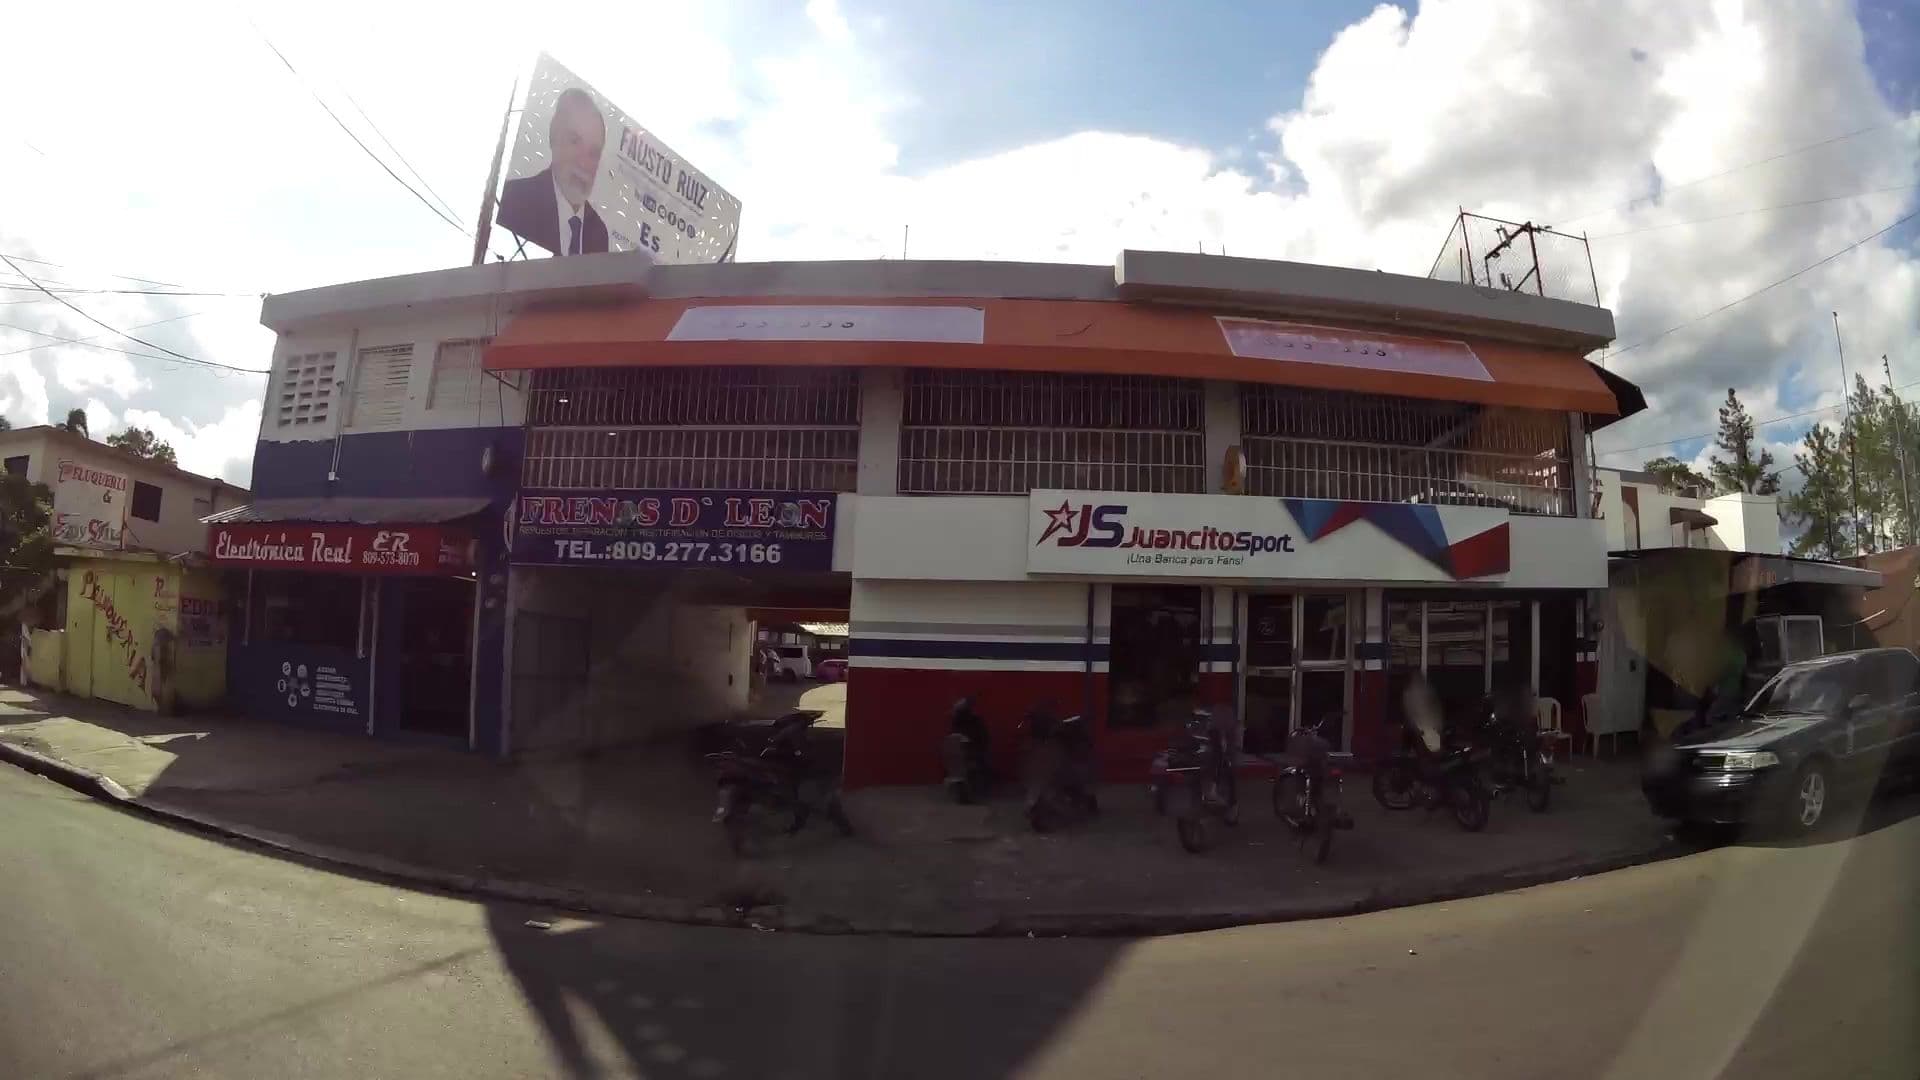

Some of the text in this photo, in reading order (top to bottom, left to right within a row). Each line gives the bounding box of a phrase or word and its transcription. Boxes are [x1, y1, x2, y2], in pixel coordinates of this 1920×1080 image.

[620, 126, 708, 211] FAUSTO RUIZ
[103, 490, 112, 504] &
[1057, 504, 1128, 548] JS
[310, 532, 353, 563] Real
[372, 530, 411, 552] ER
[554, 539, 781, 565] TEL.:809.277.3166
[1154, 553, 1187, 564] Banca
[1190, 556, 1214, 566] para
